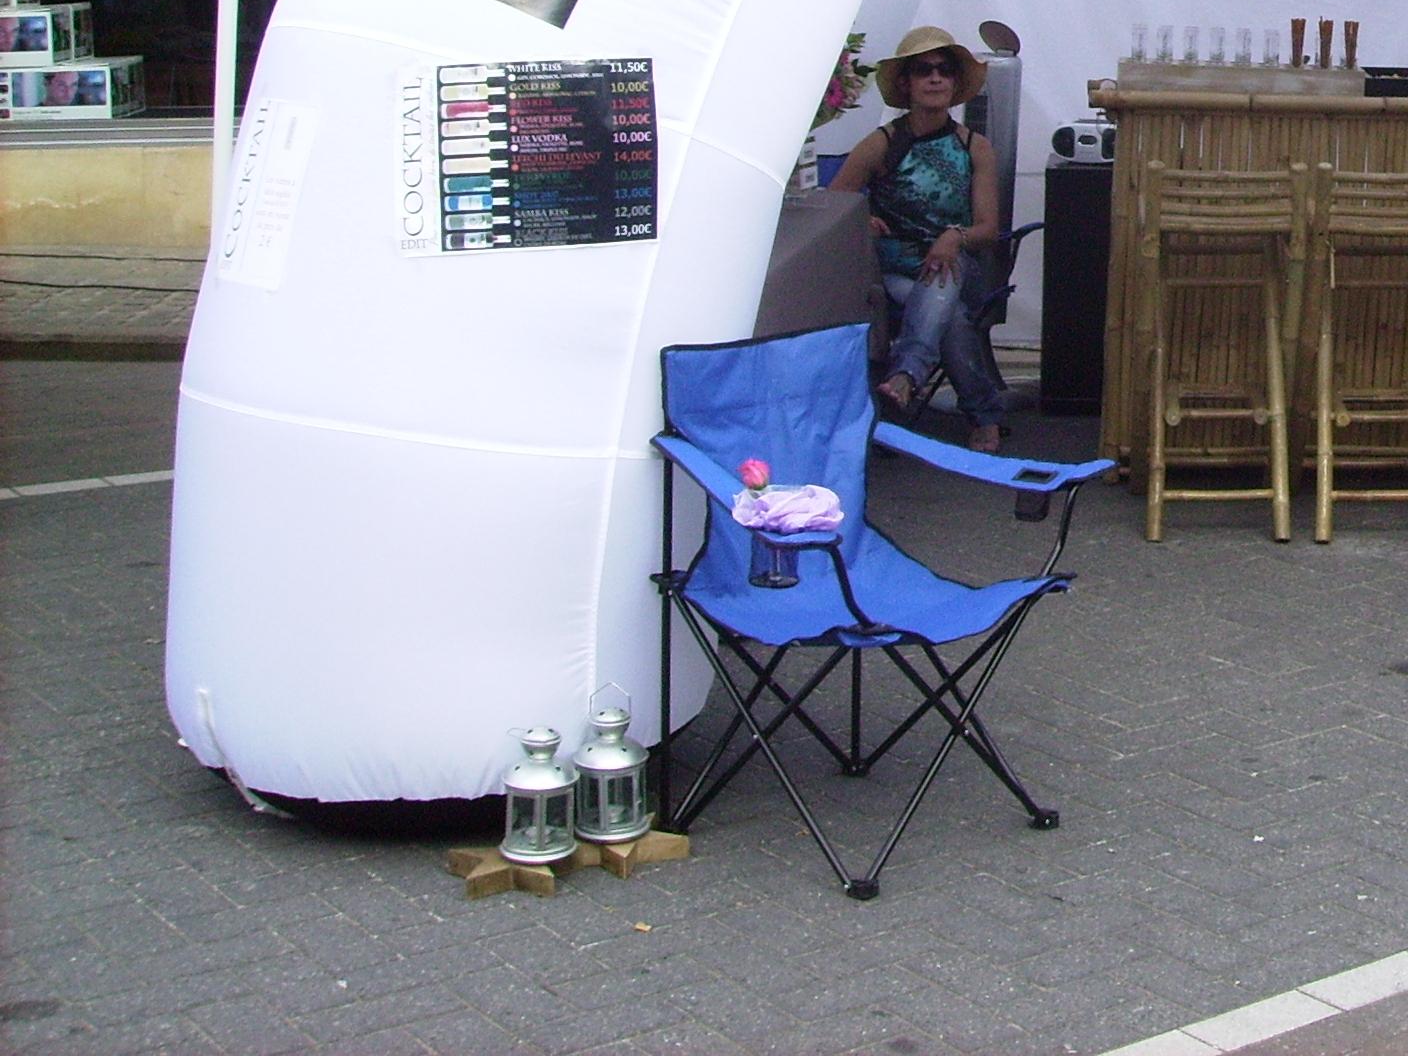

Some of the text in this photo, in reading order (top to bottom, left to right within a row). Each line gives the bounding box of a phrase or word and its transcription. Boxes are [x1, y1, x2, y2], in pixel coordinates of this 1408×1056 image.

[507, 62, 648, 74] WHITE KISS 11,50€
[540, 82, 561, 91] KISS
[611, 81, 649, 93] 10,00€
[612, 114, 651, 126] 10,00€
[532, 133, 568, 143] VODKA
[613, 132, 652, 144] 10,00€
[403, 76, 425, 237] COCKTAIL
[615, 205, 652, 217] 12,00€
[614, 224, 652, 237] 13,00€
[400, 239, 429, 250] EDIT
